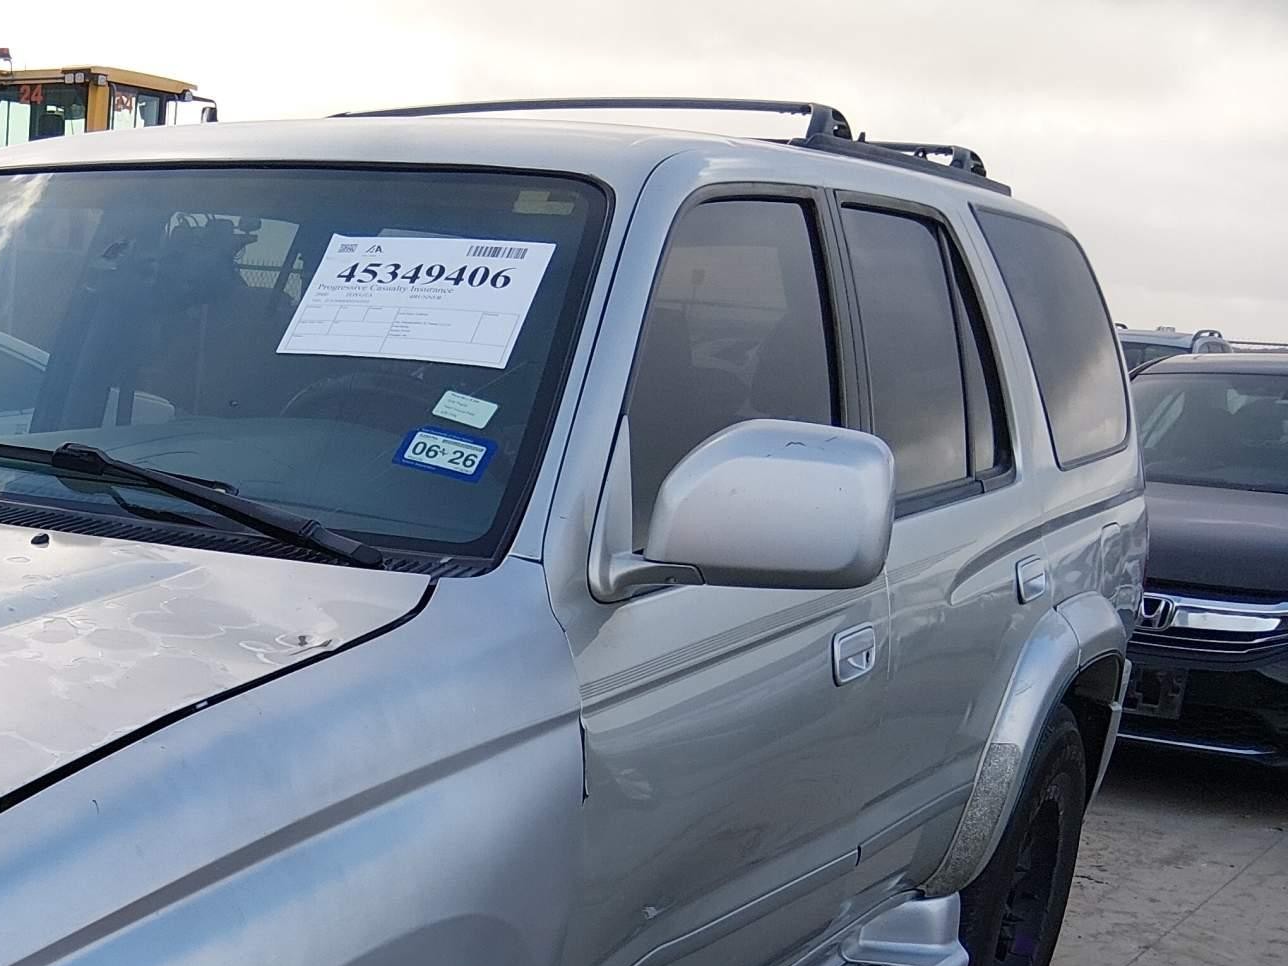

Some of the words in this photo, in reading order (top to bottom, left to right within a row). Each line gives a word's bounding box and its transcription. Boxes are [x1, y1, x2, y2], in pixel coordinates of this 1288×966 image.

[19, 83, 44, 105] 24
[336, 261, 518, 289] 45349406
[317, 283, 370, 293] Progressive
[369, 283, 409, 295] Casualty
[409, 285, 455, 295] Insurance
[411, 441, 441, 459] 06
[447, 450, 479, 468] 26
